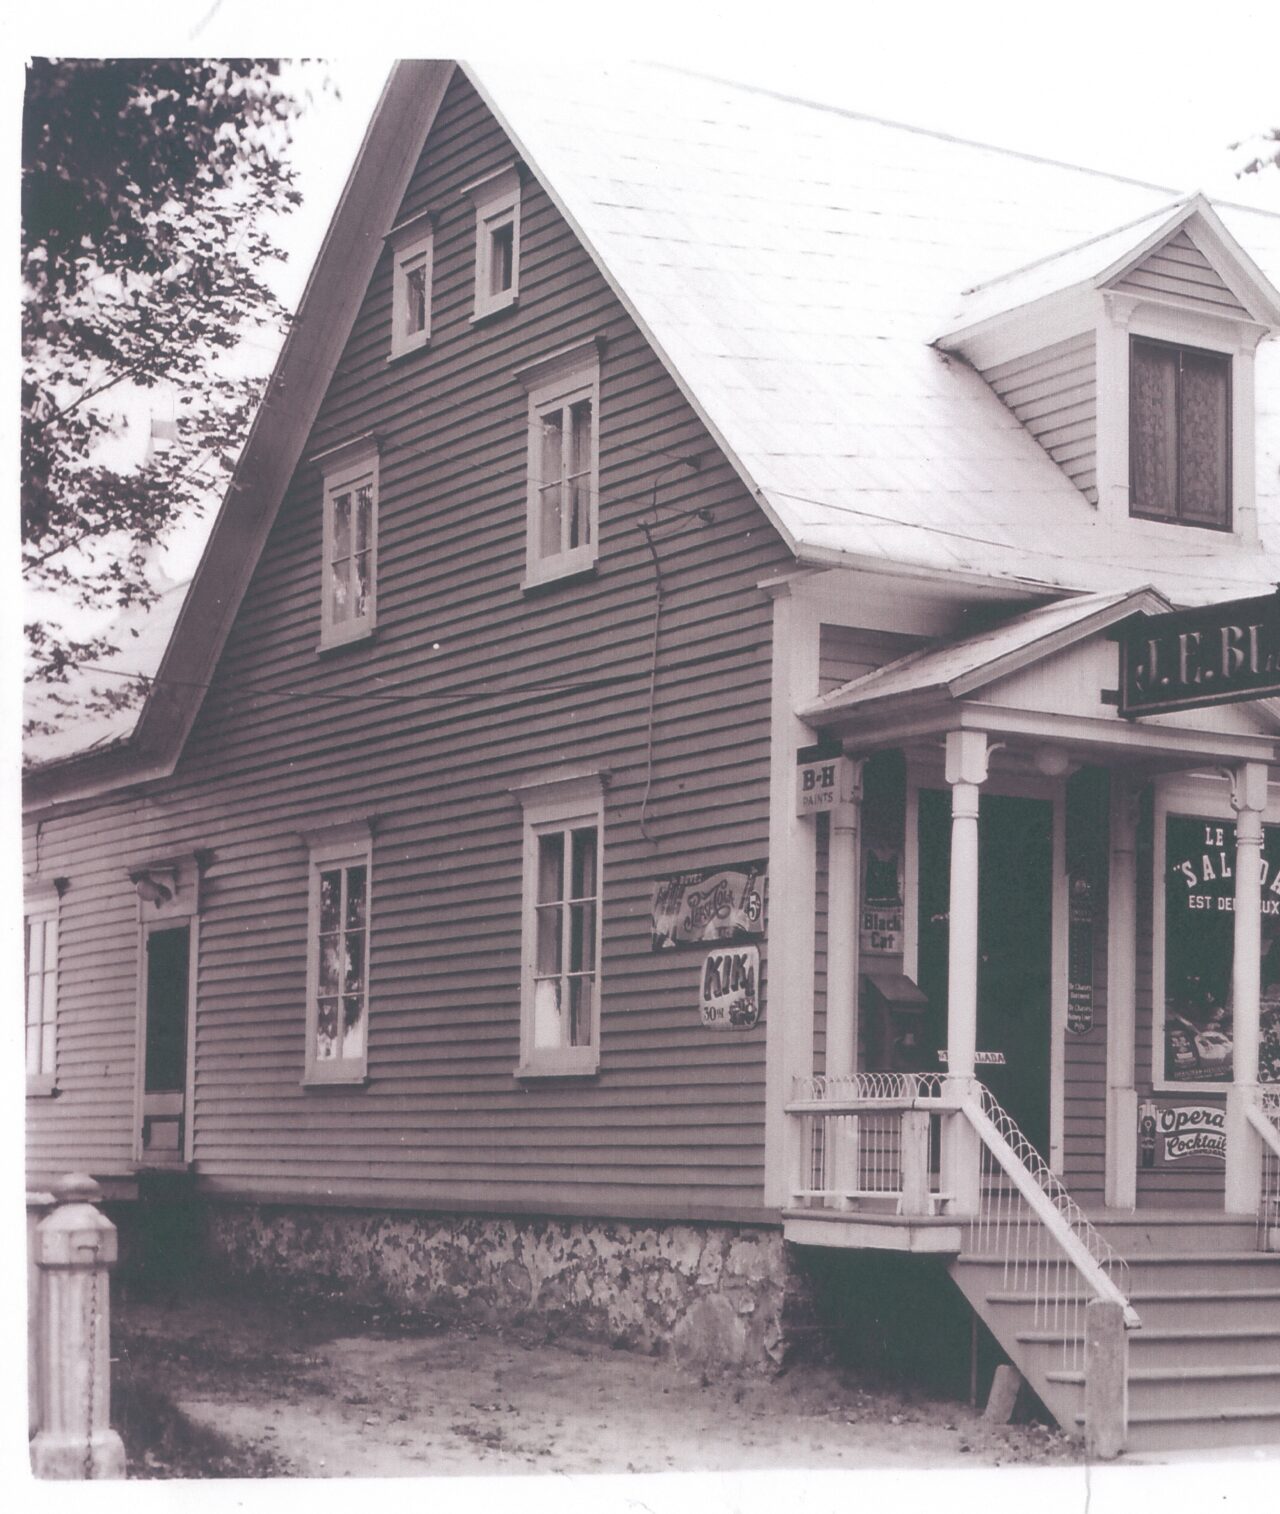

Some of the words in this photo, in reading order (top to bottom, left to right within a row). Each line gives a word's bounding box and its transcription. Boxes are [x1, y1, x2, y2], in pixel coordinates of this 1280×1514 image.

[1205, 827, 1223, 846] LE
[1188, 895, 1212, 910] EST
[864, 913, 901, 932] Black
[871, 931, 895, 949] Cat
[704, 953, 747, 1002] KIK
